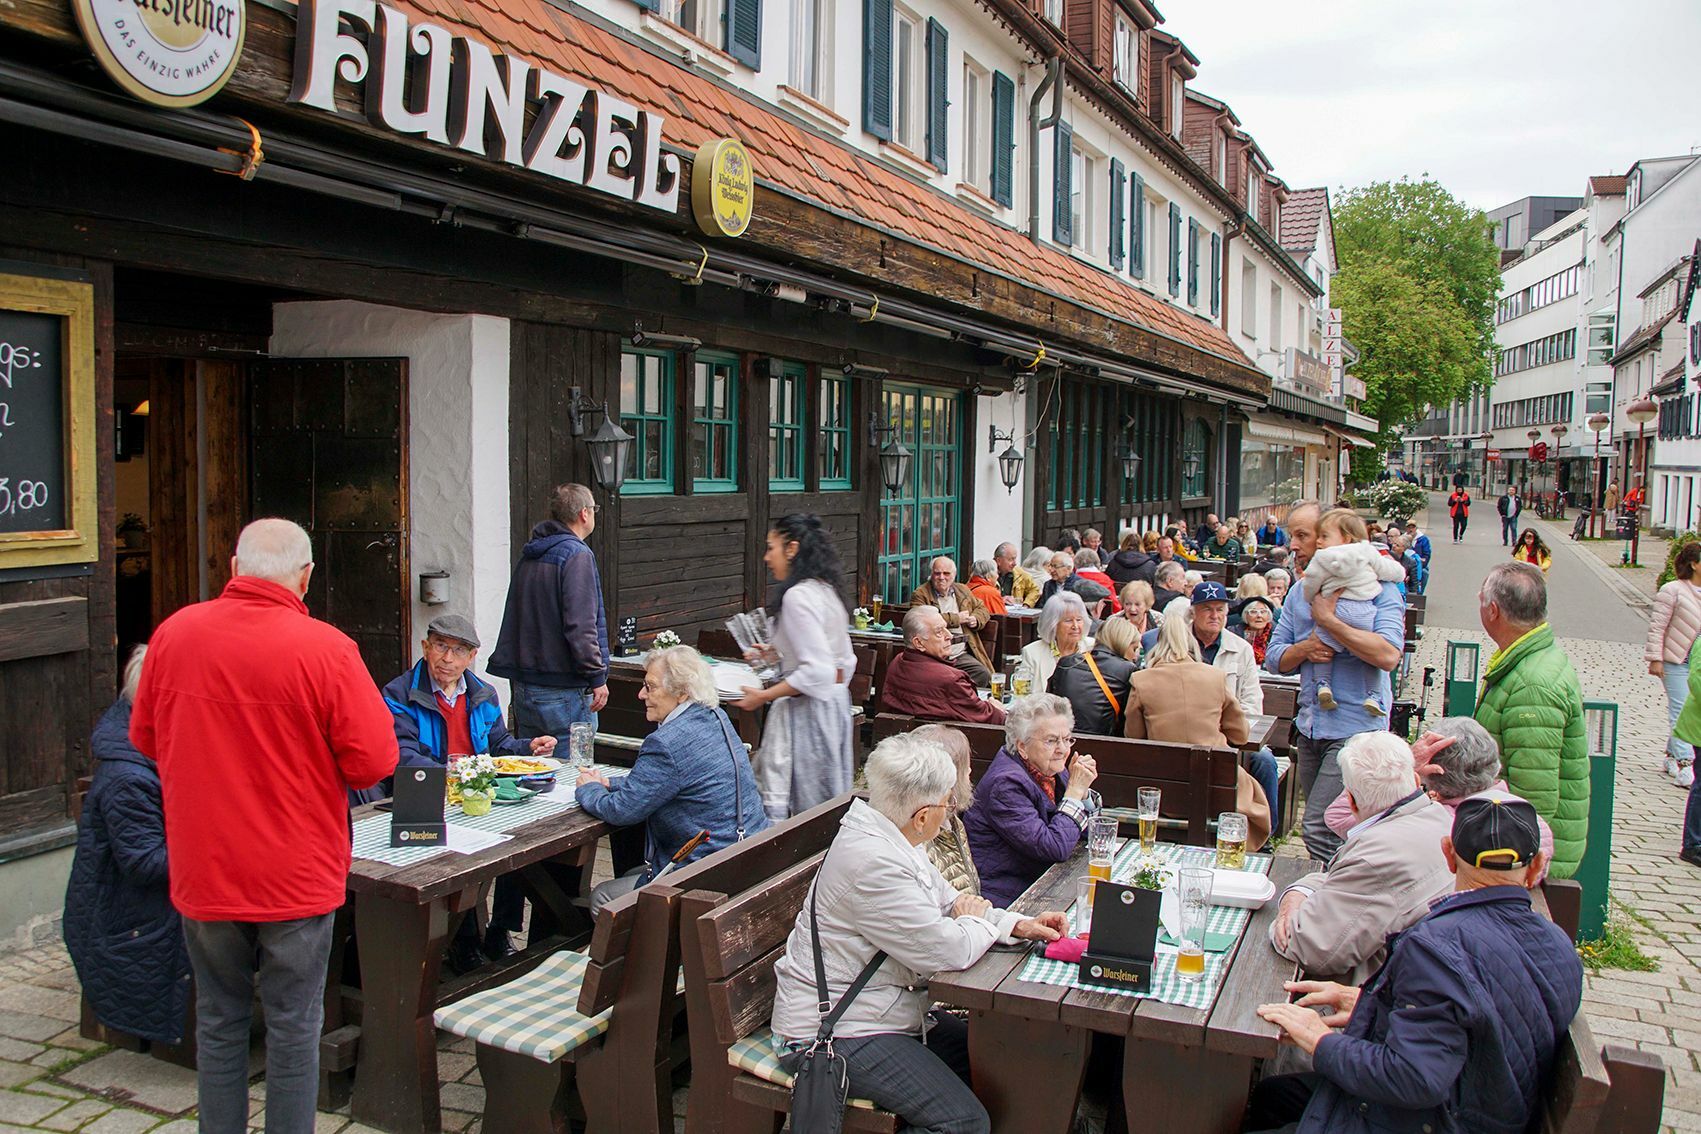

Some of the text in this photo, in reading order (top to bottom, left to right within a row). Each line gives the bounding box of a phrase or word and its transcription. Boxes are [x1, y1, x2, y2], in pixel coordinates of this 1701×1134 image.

[118, 0, 235, 39] steiner
[114, 19, 221, 80] DAS EINZIG WAHRE
[298, 0, 680, 214] FUNZEL
[1103, 966, 1139, 983] Warsteiner
